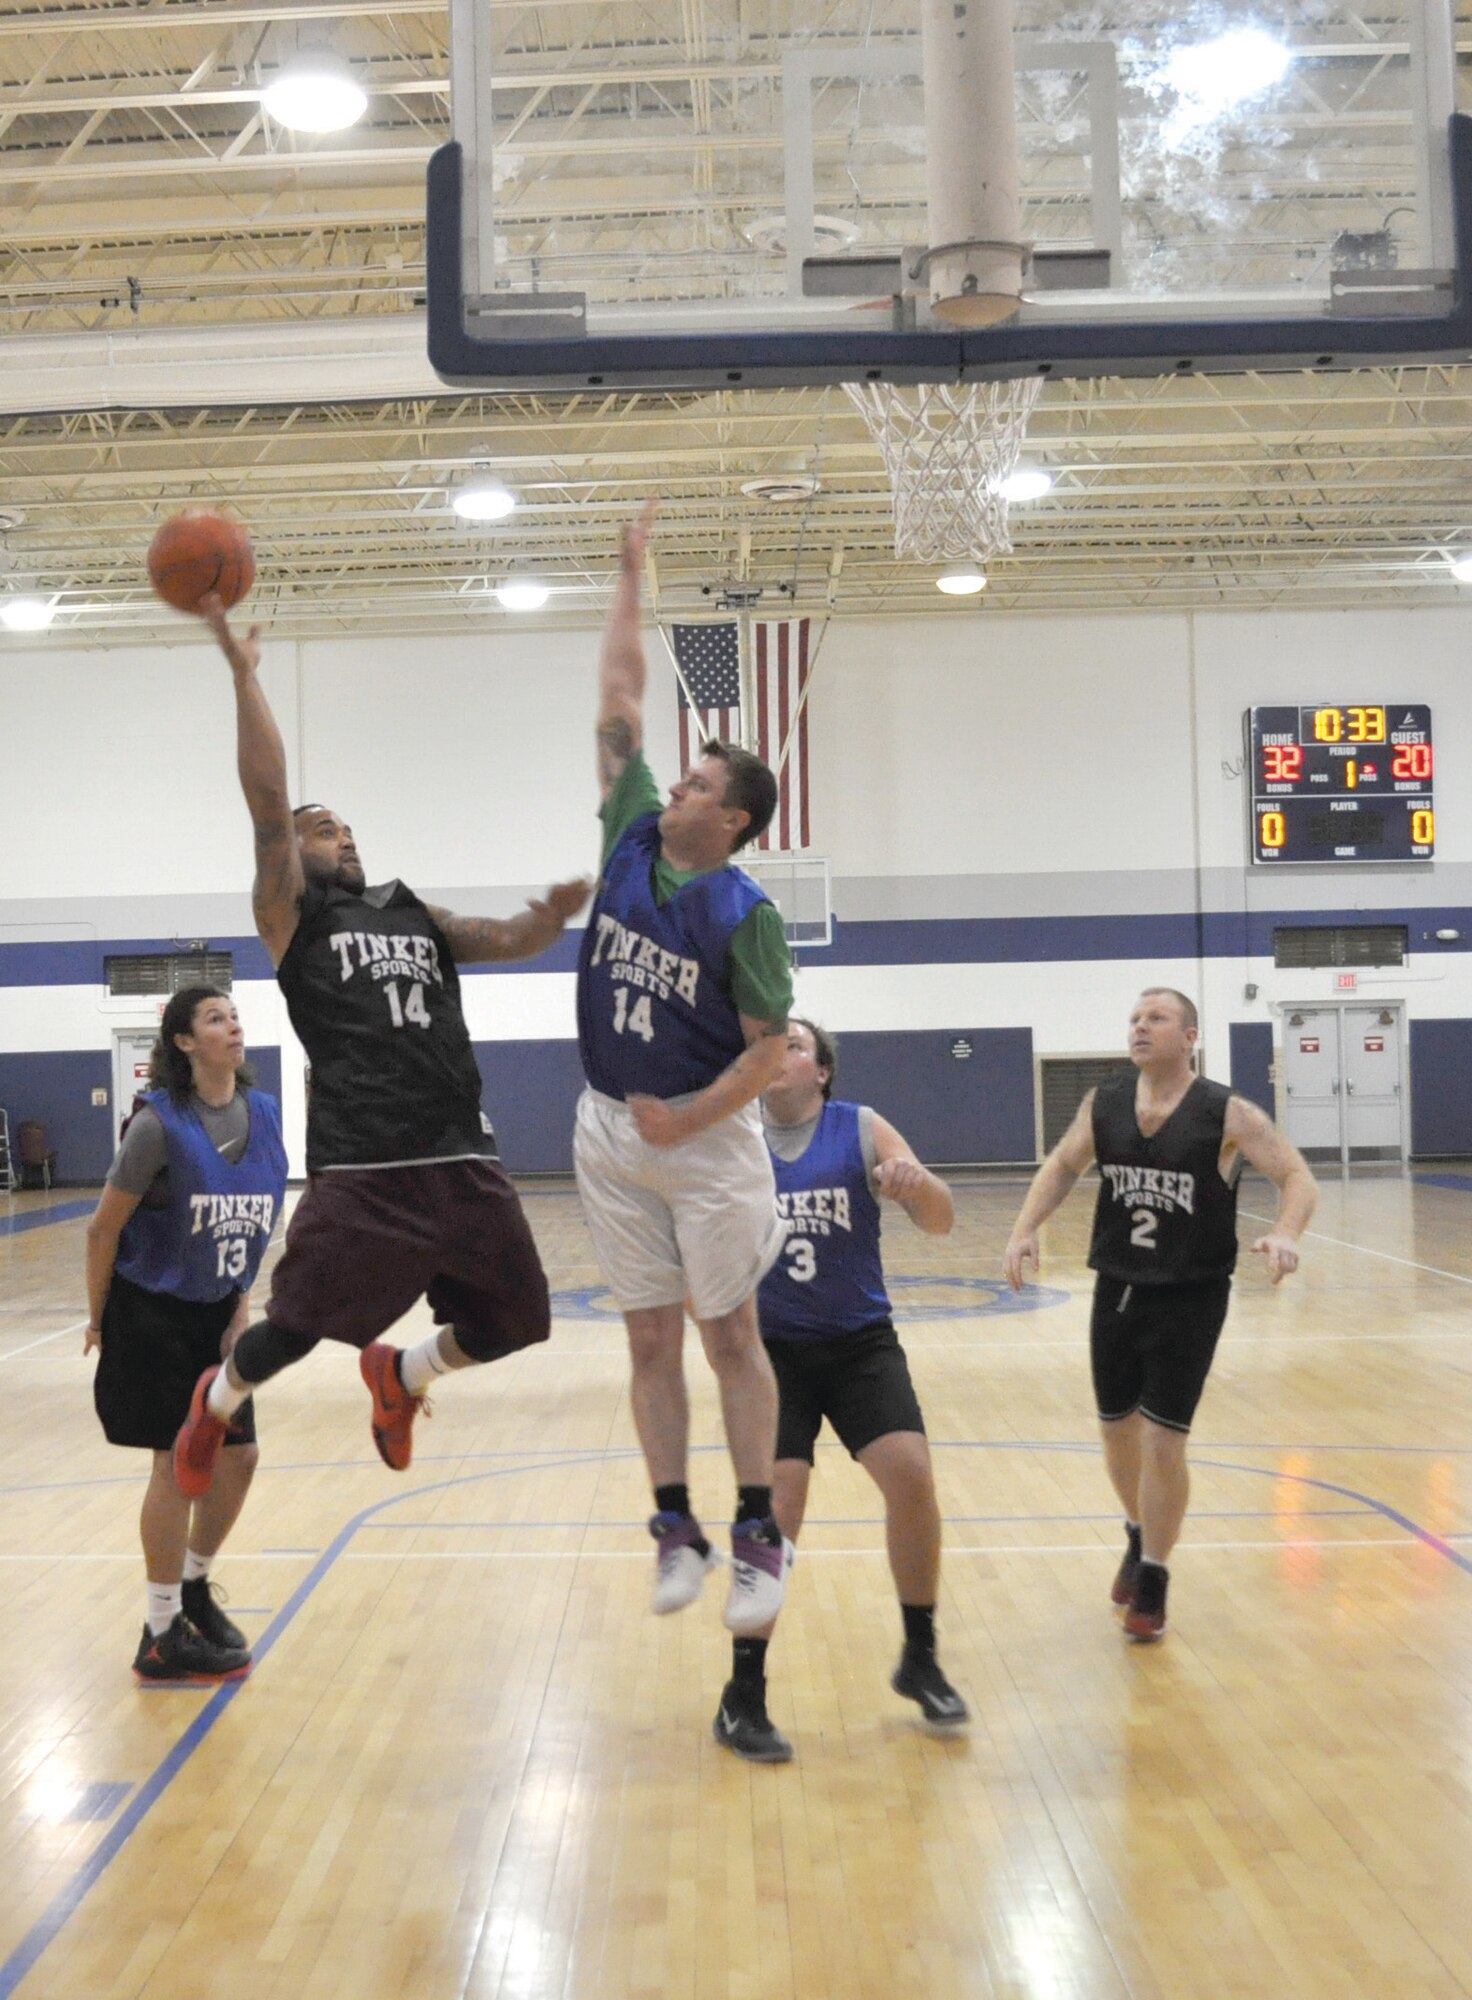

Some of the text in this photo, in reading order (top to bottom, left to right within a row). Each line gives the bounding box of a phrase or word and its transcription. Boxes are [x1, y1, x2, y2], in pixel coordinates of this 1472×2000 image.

[1262, 733, 1294, 746] HOME
[1329, 746, 1357, 756] PERIOD
[1391, 731, 1425, 745] GUEST
[1263, 746, 1301, 780] 32
[1345, 759, 1358, 789] 1
[1392, 744, 1432, 779] 20
[1266, 783, 1293, 793] BONUS
[1394, 781, 1421, 791] BONUS
[1257, 803, 1281, 812] FOULS
[1330, 801, 1358, 811] PLAYER
[1407, 800, 1431, 810] FOULS
[1261, 812, 1286, 847] 0
[1411, 809, 1434, 845] 0
[1261, 848, 1279, 858] WON
[1334, 846, 1356, 856] GAME
[1411, 845, 1429, 855] WON
[590, 913, 700, 1009] TINKER
[610, 962, 670, 1001] SPORTS
[383, 981, 432, 1029] 14
[613, 986, 655, 1042] 14
[1102, 1164, 1195, 1216] TINKER
[189, 1193, 274, 1236] TINKER
[775, 1186, 852, 1233] NKER
[1130, 1208, 1157, 1249] 2
[216, 1238, 247, 1278] 13
[785, 1237, 817, 1282] 3
